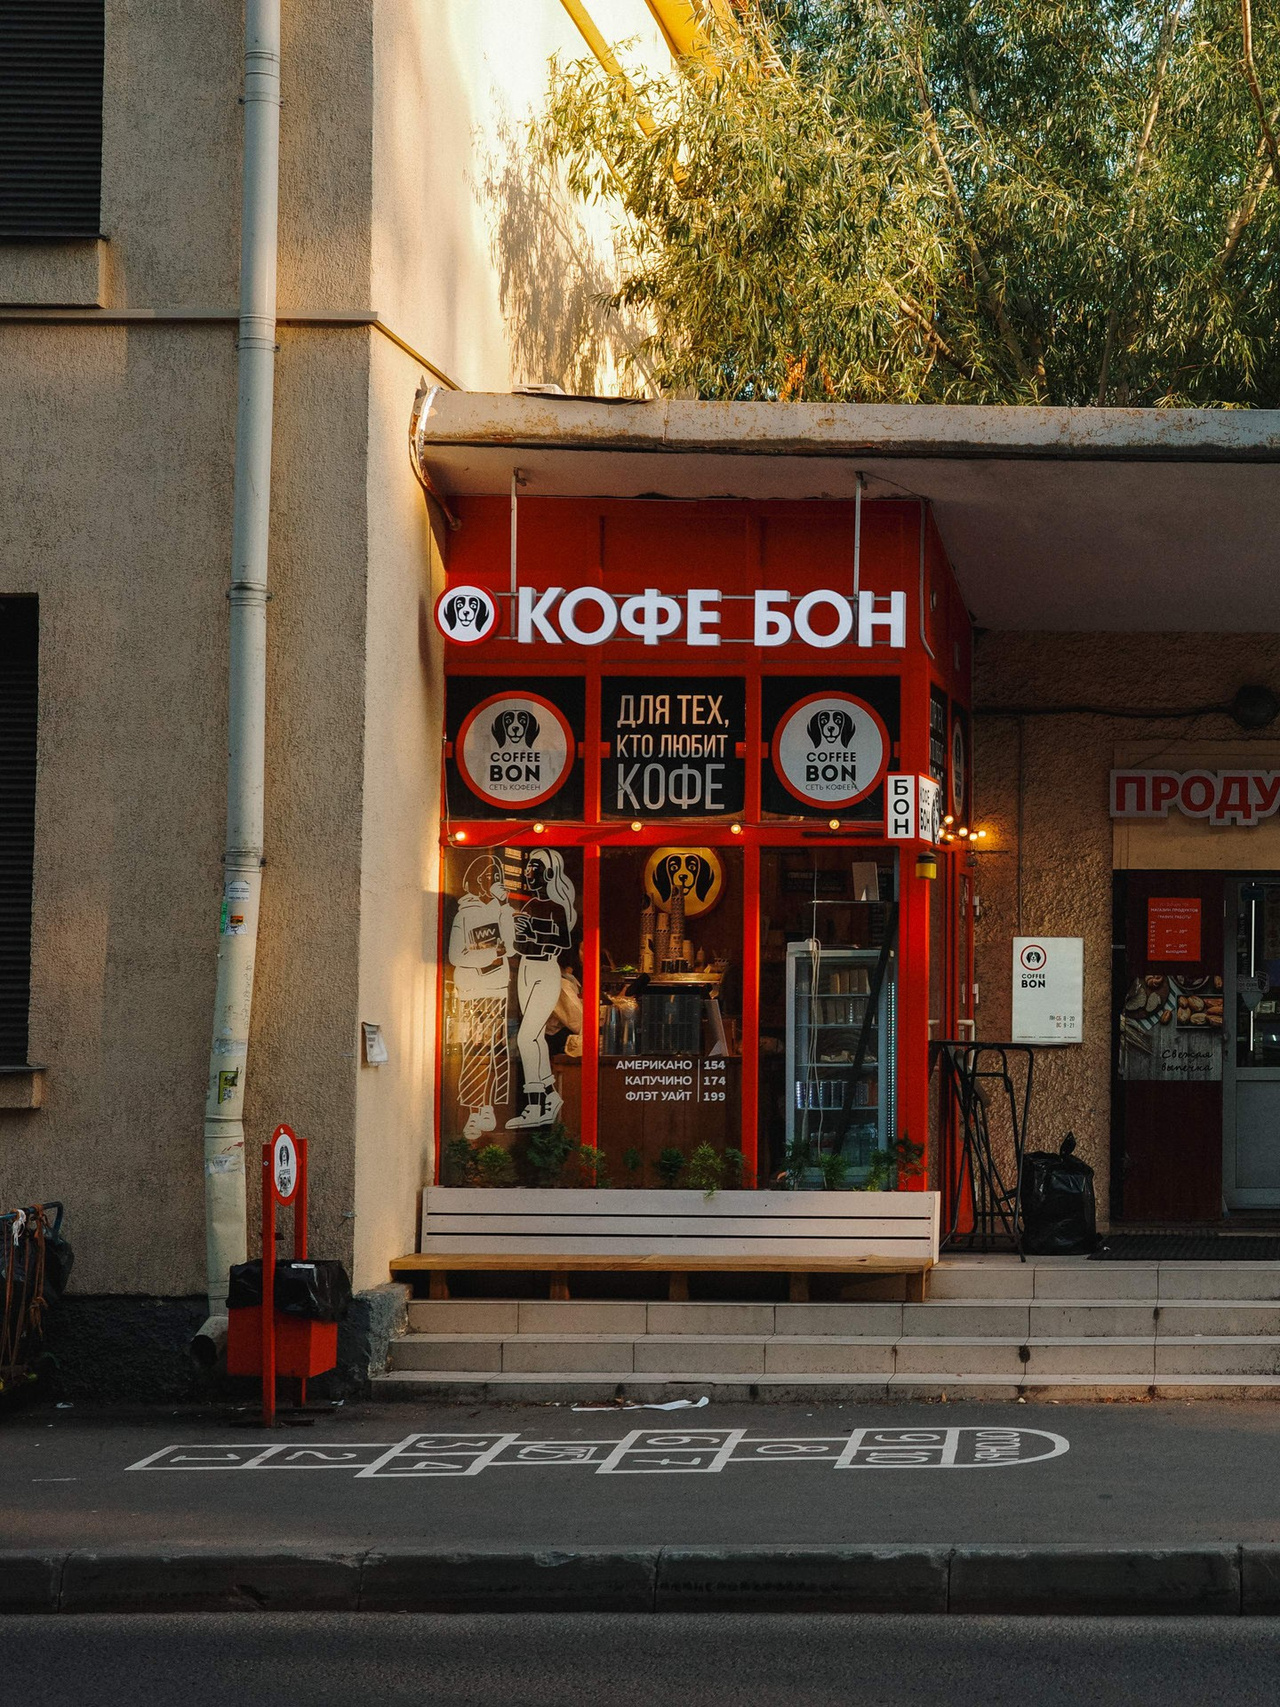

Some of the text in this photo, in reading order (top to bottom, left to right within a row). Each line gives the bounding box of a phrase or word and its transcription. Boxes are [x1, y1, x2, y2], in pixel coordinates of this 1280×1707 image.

[518, 586, 906, 649] КОФЕ БОН
[617, 695, 729, 729] ДЛЯ ТЕХ,
[617, 734, 729, 758] КТО ЛЮБИТ
[490, 752, 541, 763] COFFEE
[806, 752, 857, 763] COFFEE
[490, 764, 541, 782] BON
[806, 764, 857, 782] BON
[617, 763, 726, 810] КОФЕ
[893, 779, 909, 834] БОН
[1021, 979, 1046, 988] BON
[1161, 1049, 1213, 1061] Свежая
[616, 1060, 726, 1070] АМЕРИКАНО 154
[1161, 1063, 1213, 1071] выпечка
[625, 1076, 726, 1086] КАПУЧИНО 174
[625, 1089, 726, 1102] ФЛЭТ УАЙТ 199
[646, 1436, 721, 1446] 6
[875, 1433, 941, 1442] 9
[416, 1440, 489, 1449] 3
[756, 1444, 829, 1454] 8
[170, 1453, 240, 1463] 1
[285, 1450, 357, 1461] 2
[866, 1450, 932, 1464] 10
[389, 1461, 464, 1470] 4
